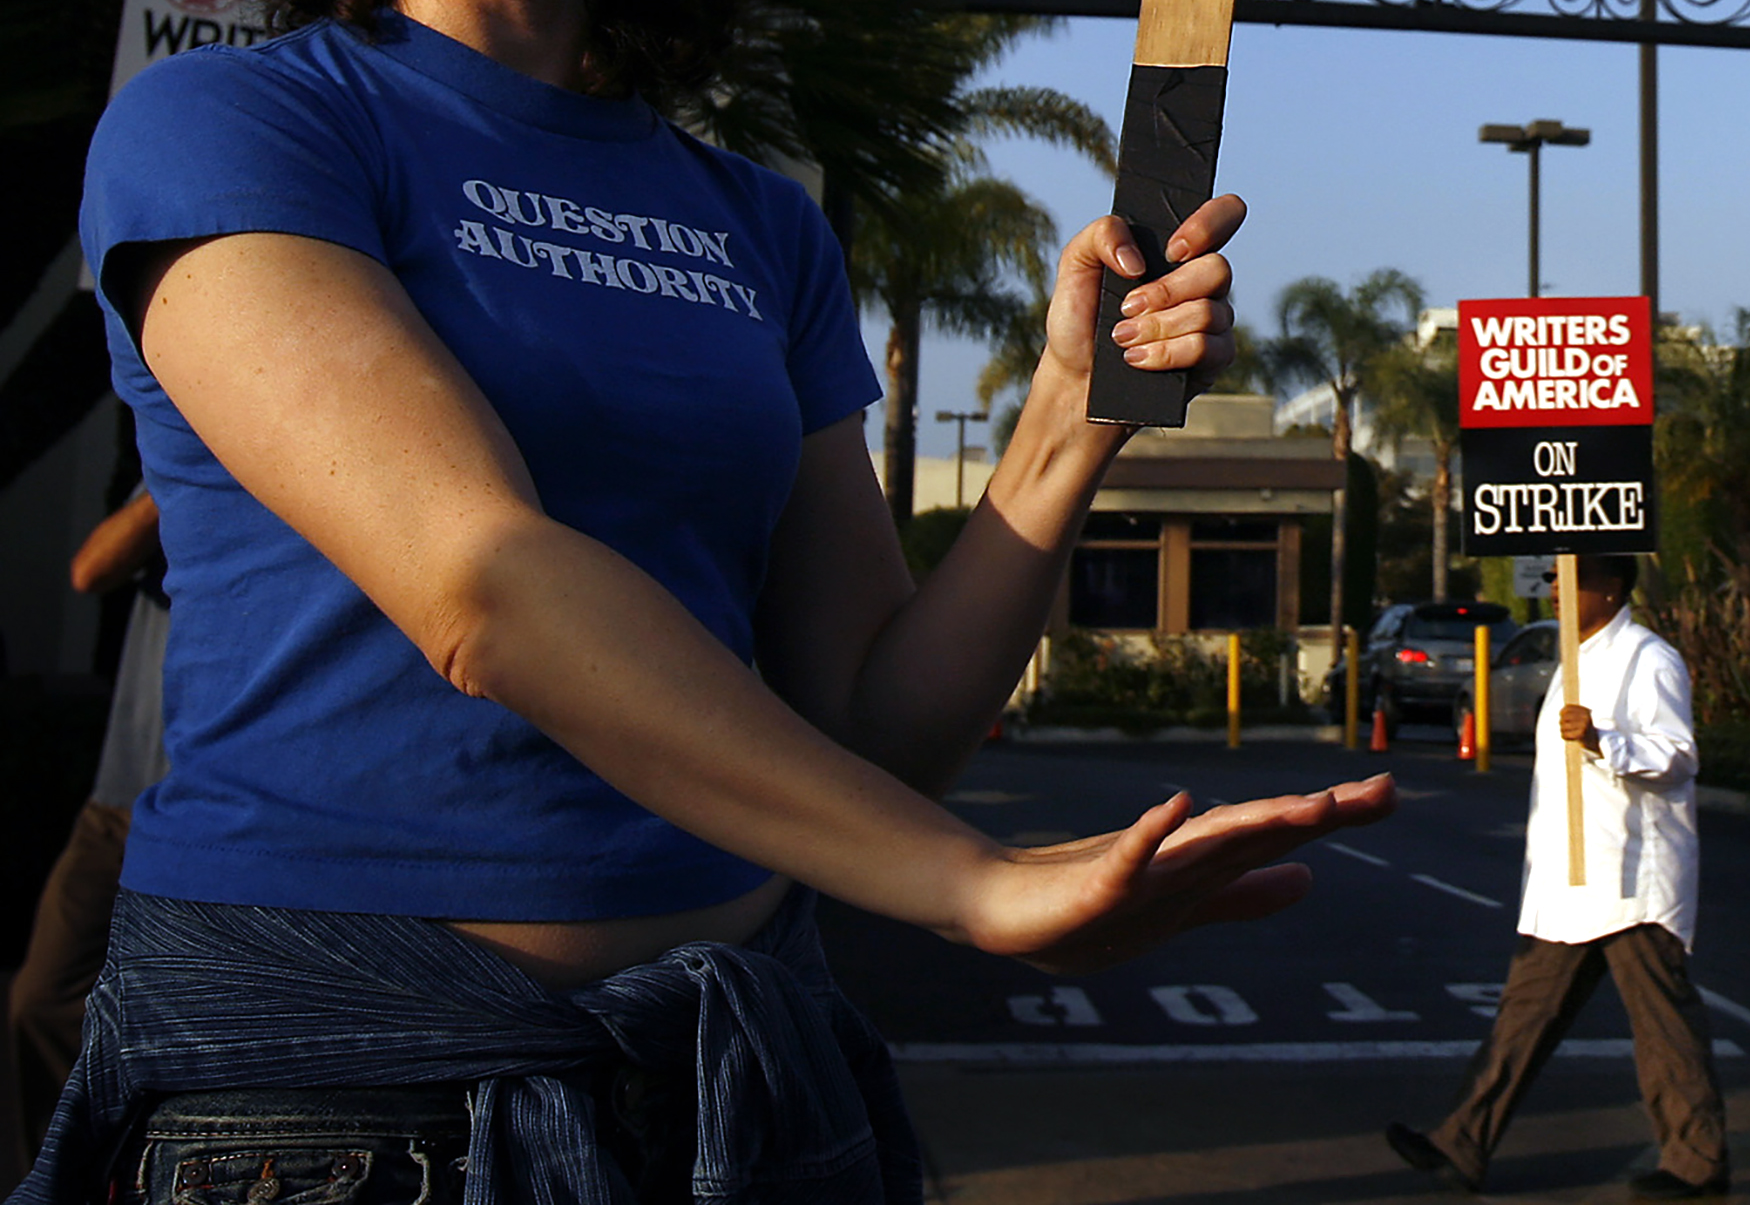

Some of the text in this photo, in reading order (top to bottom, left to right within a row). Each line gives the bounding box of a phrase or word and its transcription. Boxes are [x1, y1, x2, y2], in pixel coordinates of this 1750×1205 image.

[144, 8, 268, 58] WRIT
[462, 179, 735, 269] QUESTION
[454, 220, 763, 322] AUTHORITY
[1471, 314, 1631, 347] WRITERS
[1480, 347, 1628, 379] GUILD OF
[1472, 378, 1640, 411] AMERICA
[1533, 441, 1578, 477] ON
[1474, 481, 1645, 535] STRIKE
